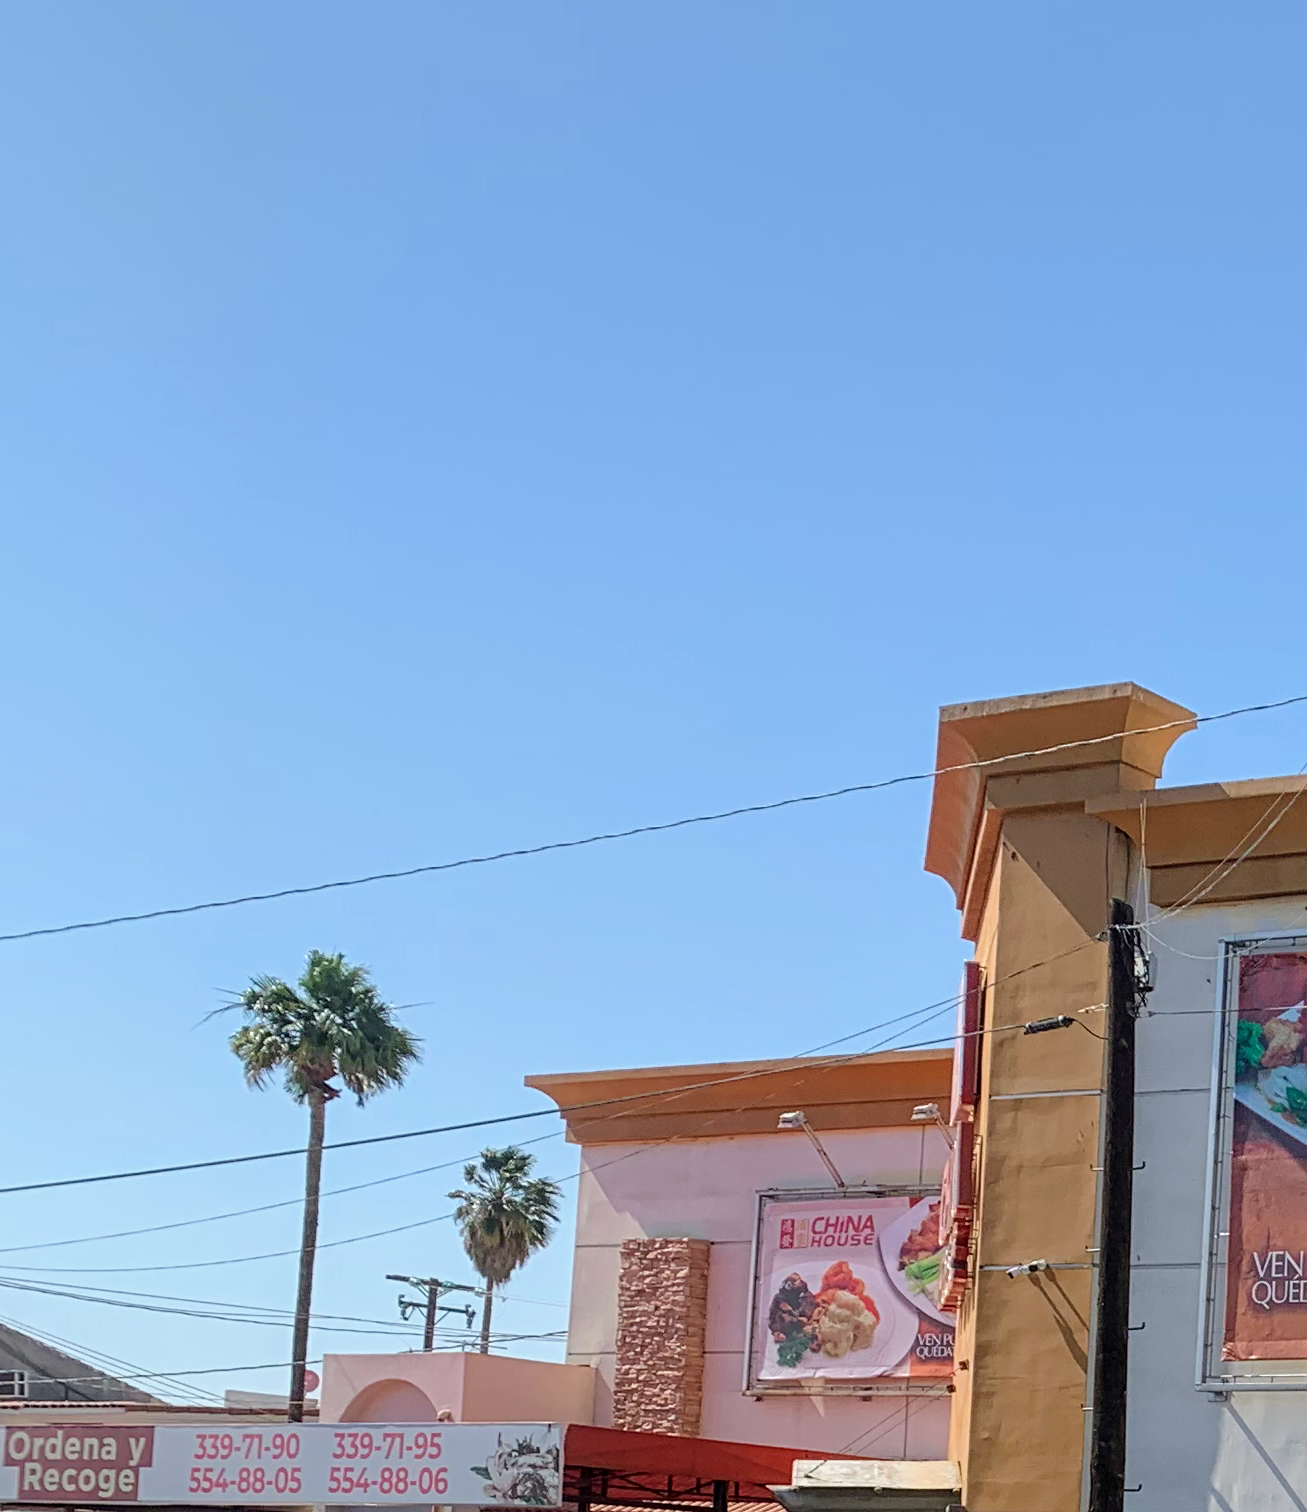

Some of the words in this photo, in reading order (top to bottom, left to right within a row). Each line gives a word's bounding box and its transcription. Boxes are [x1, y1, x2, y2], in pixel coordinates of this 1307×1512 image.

[811, 1215, 875, 1235] CHINA
[810, 1233, 875, 1247] HOUSE
[1253, 1250, 1304, 1278] VEN
[916, 1344, 955, 1360] QUÉDA
[918, 1333, 942, 1346] VEN
[8, 1430, 117, 1460] Ordena
[128, 1436, 146, 1467] y
[193, 1433, 300, 1460] 339-71-90
[332, 1432, 442, 1460] 339-71-95
[23, 1462, 135, 1498] Recoge
[188, 1467, 302, 1494] 554-88-05
[328, 1466, 449, 1494] 554-88-06
